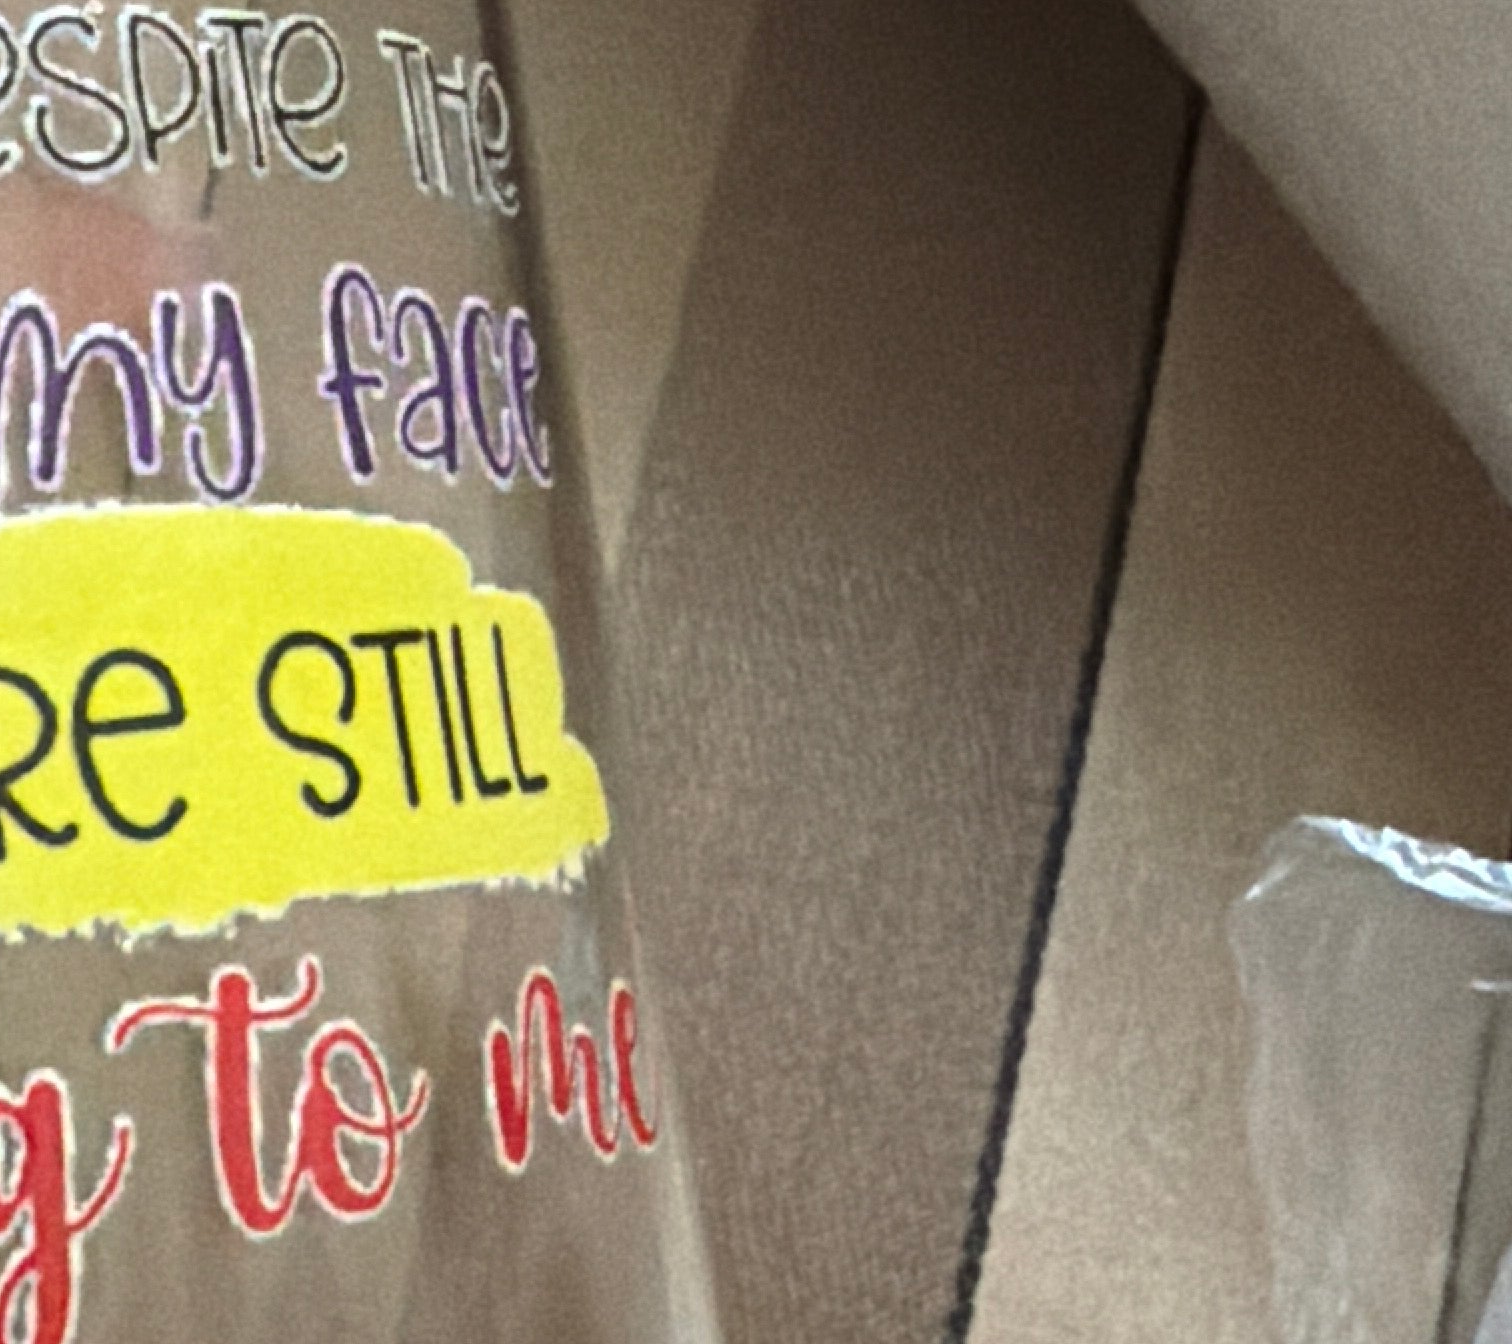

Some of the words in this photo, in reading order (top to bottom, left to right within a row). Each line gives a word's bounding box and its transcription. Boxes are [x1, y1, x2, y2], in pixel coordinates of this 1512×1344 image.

[318, 263, 552, 487] face
[256, 622, 548, 819] STILL
[106, 954, 430, 1238] to
[486, 966, 660, 1174] me
